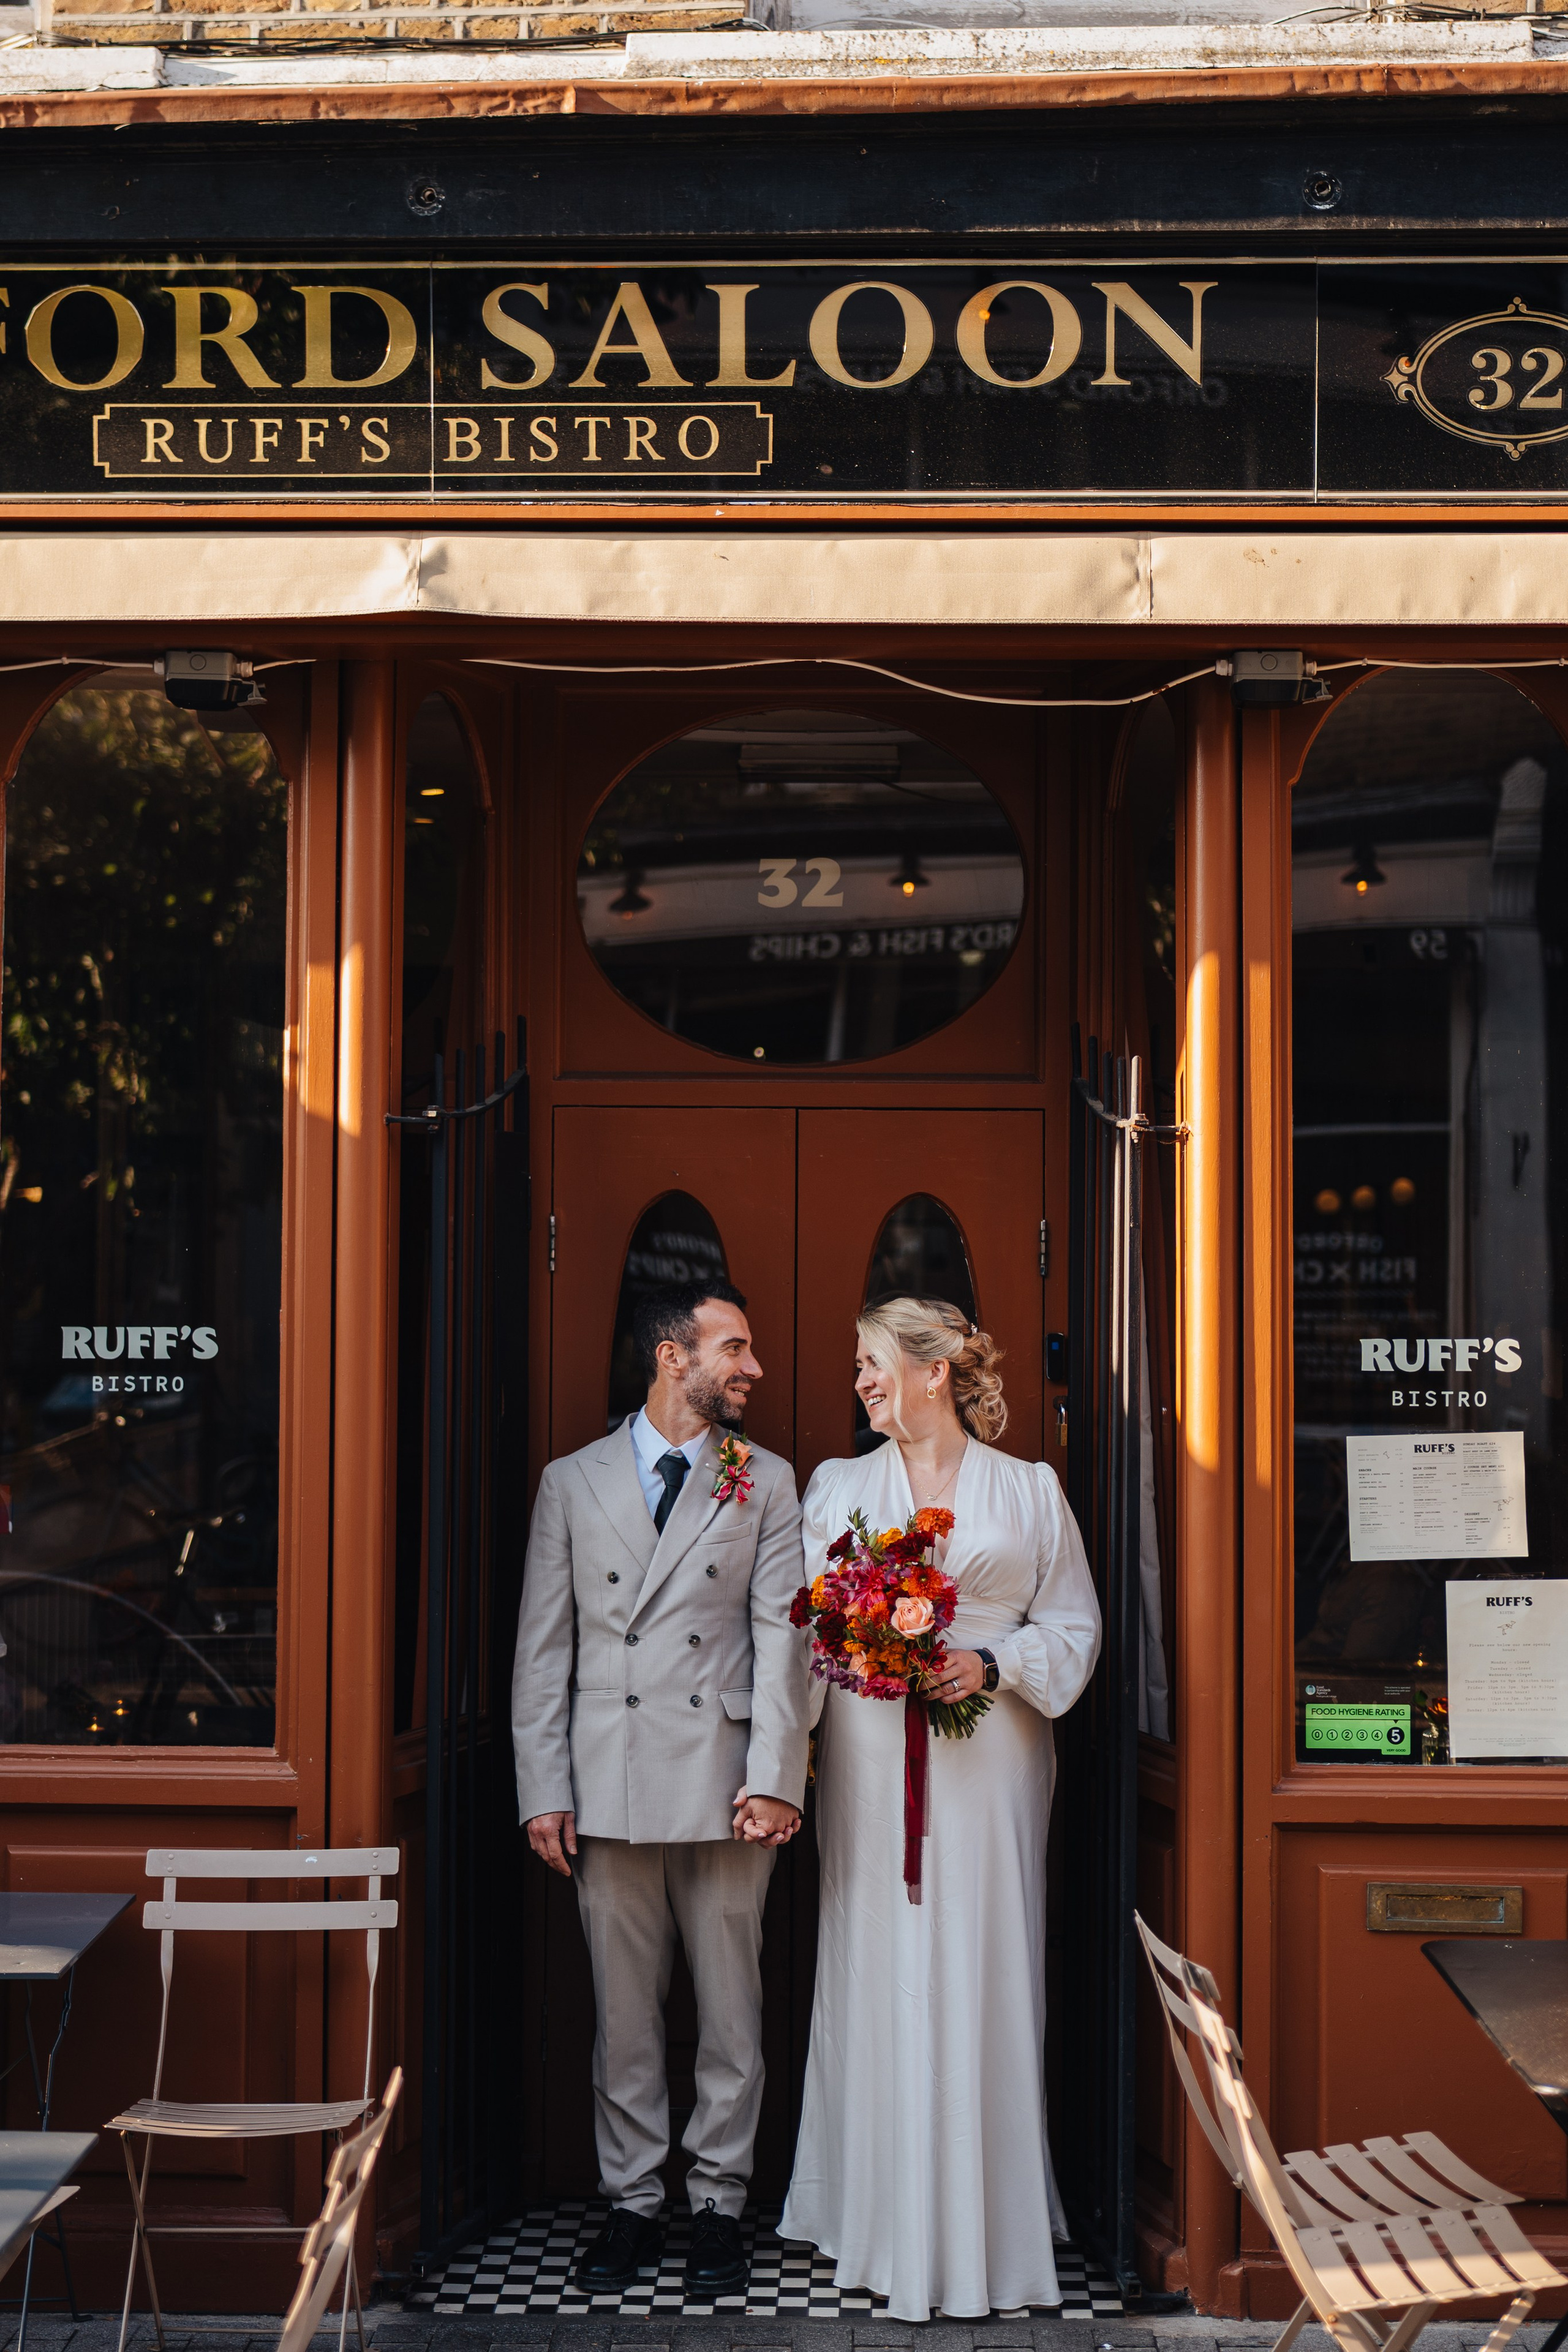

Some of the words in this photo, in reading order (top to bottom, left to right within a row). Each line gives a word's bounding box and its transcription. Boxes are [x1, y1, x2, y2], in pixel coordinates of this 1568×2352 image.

[481, 280, 1219, 390] SALOON
[1468, 347, 1563, 410] 32
[141, 415, 391, 463] RUFF'S
[443, 415, 720, 462] BISTRO
[758, 858, 844, 908] 32
[61, 1325, 219, 1359] RUFF'S
[1359, 1338, 1522, 1373] RUFF'S
[92, 1376, 184, 1392] BISTRO
[1392, 1391, 1487, 1407] BISTRO
[1414, 1444, 1455, 1453] RUFF'S
[1486, 1597, 1532, 1607] RUFF'S
[1391, 1729, 1401, 1743] 5
